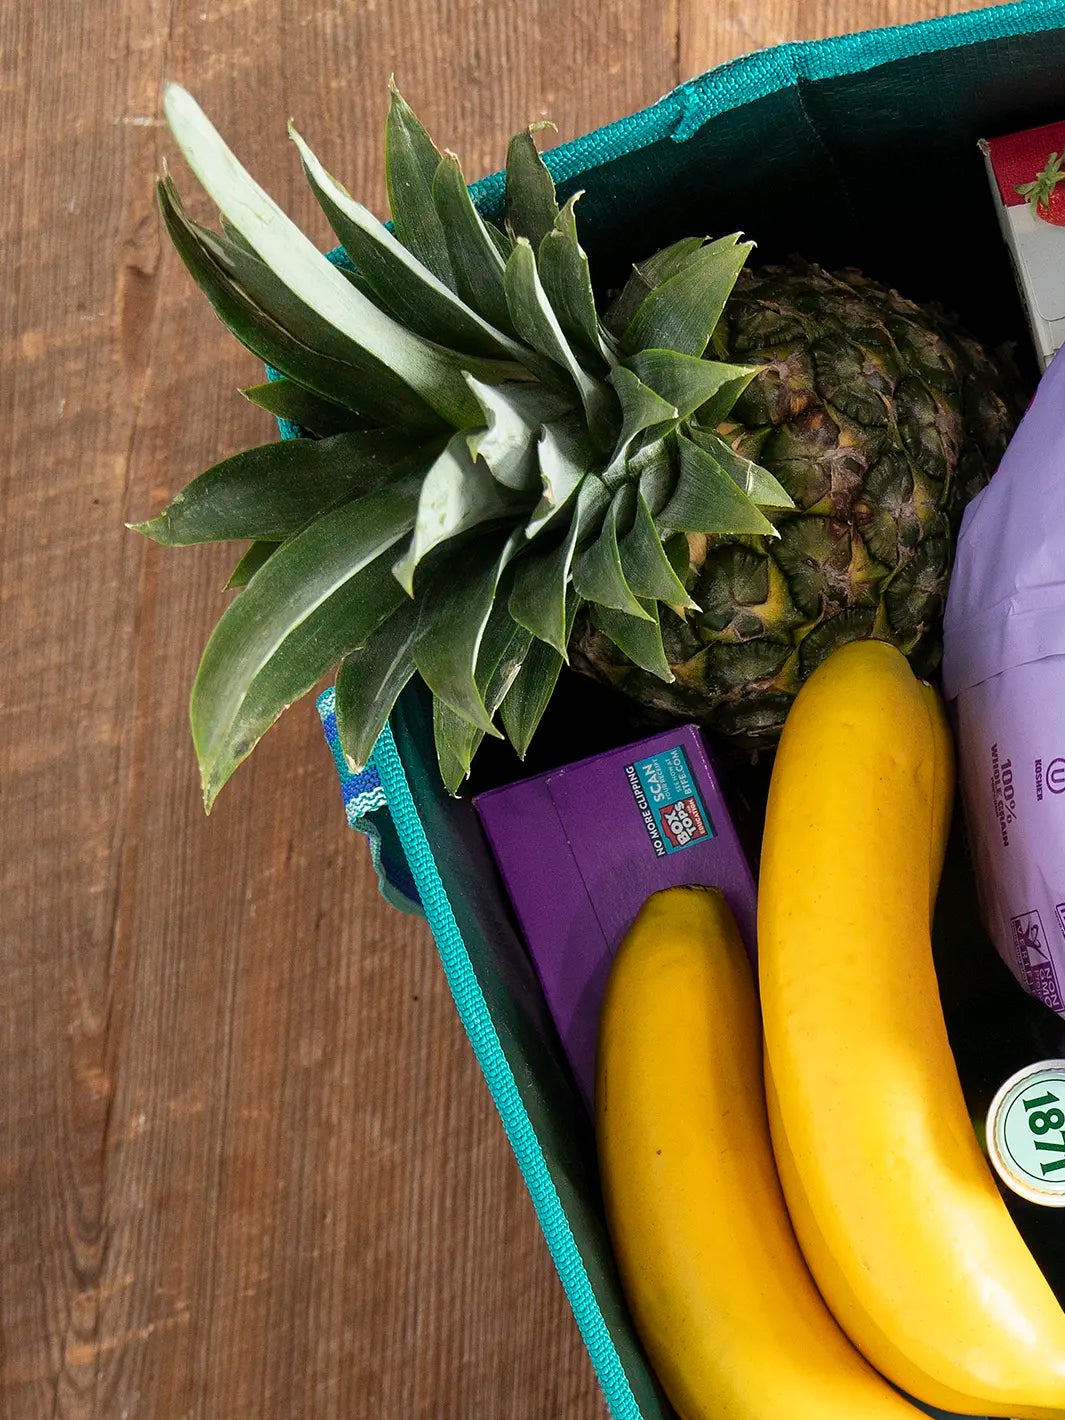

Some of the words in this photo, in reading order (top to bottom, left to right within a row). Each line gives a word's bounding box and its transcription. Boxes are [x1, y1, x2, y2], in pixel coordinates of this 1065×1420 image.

[625, 766, 648, 810] CLIPPING
[642, 763, 665, 803] SCAN
[990, 742, 1003, 797] WHOLE
[998, 799, 1010, 847] GRAIN
[1001, 758, 1017, 824] 100%
[1034, 758, 1043, 802] KOSHER
[642, 809, 660, 840] MORE
[664, 809, 691, 846] BOX
[674, 800, 697, 837] TOPS
[688, 798, 706, 835] EDUCATION
[653, 839, 666, 857] NO
[1039, 968, 1053, 1008] GMO
[1044, 966, 1060, 1007] NON
